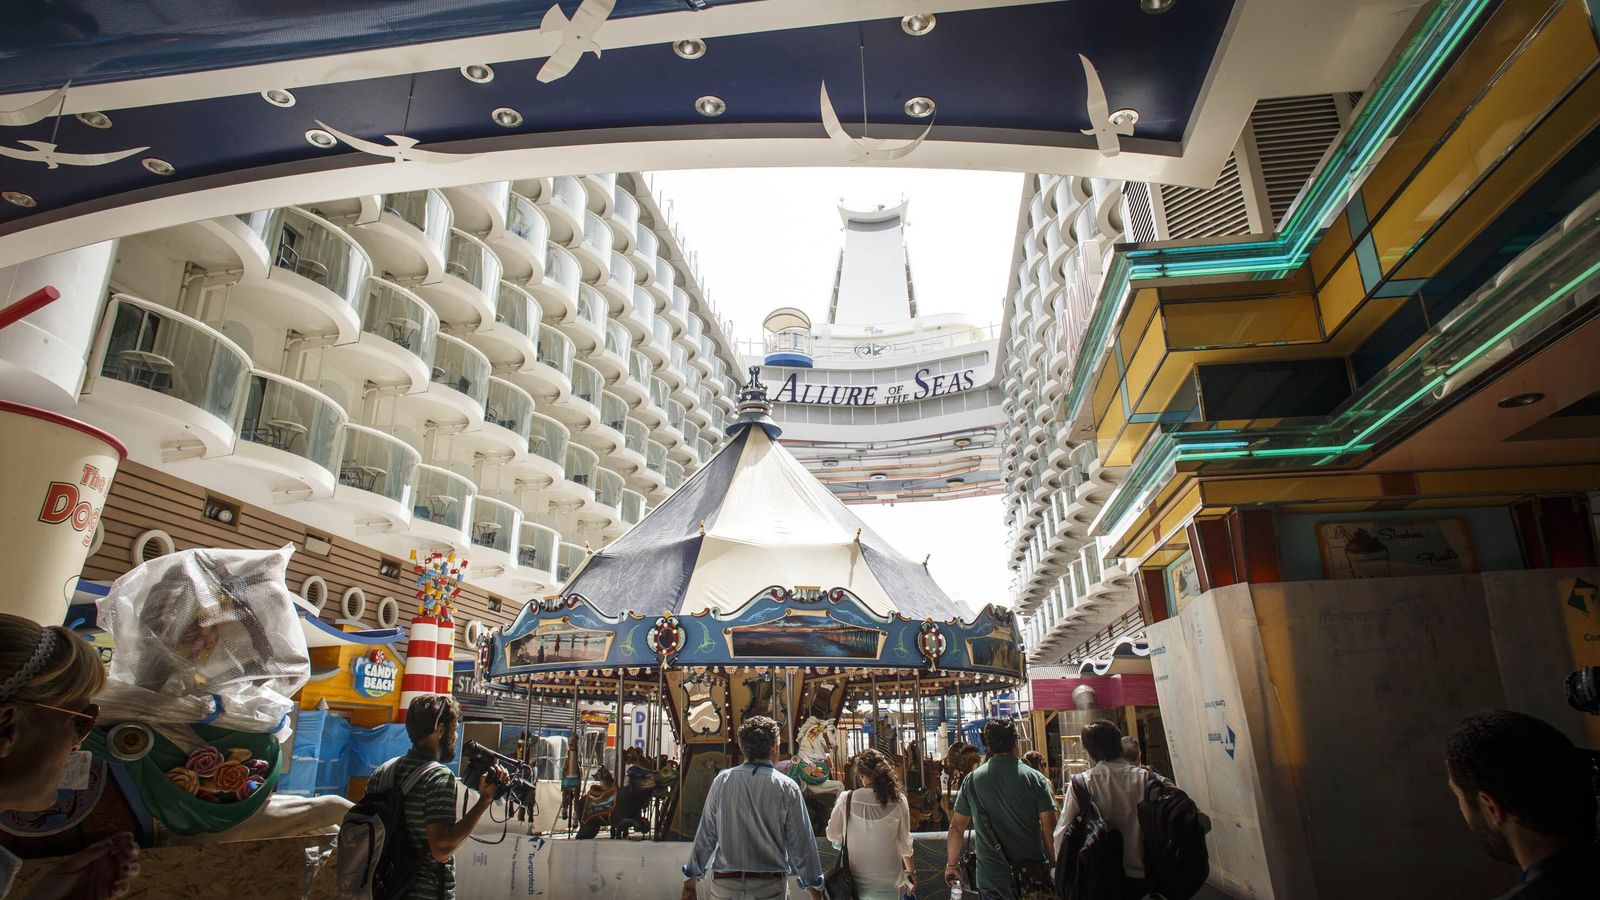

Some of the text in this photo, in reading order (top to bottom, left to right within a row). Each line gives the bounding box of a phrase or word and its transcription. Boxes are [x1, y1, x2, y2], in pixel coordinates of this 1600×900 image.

[888, 384, 904, 396] OF
[914, 368, 974, 400] SEAS
[884, 394, 910, 405] THE
[79, 463, 106, 494] The
[364, 662, 398, 681] CANDY
[363, 676, 395, 692] BEACH
